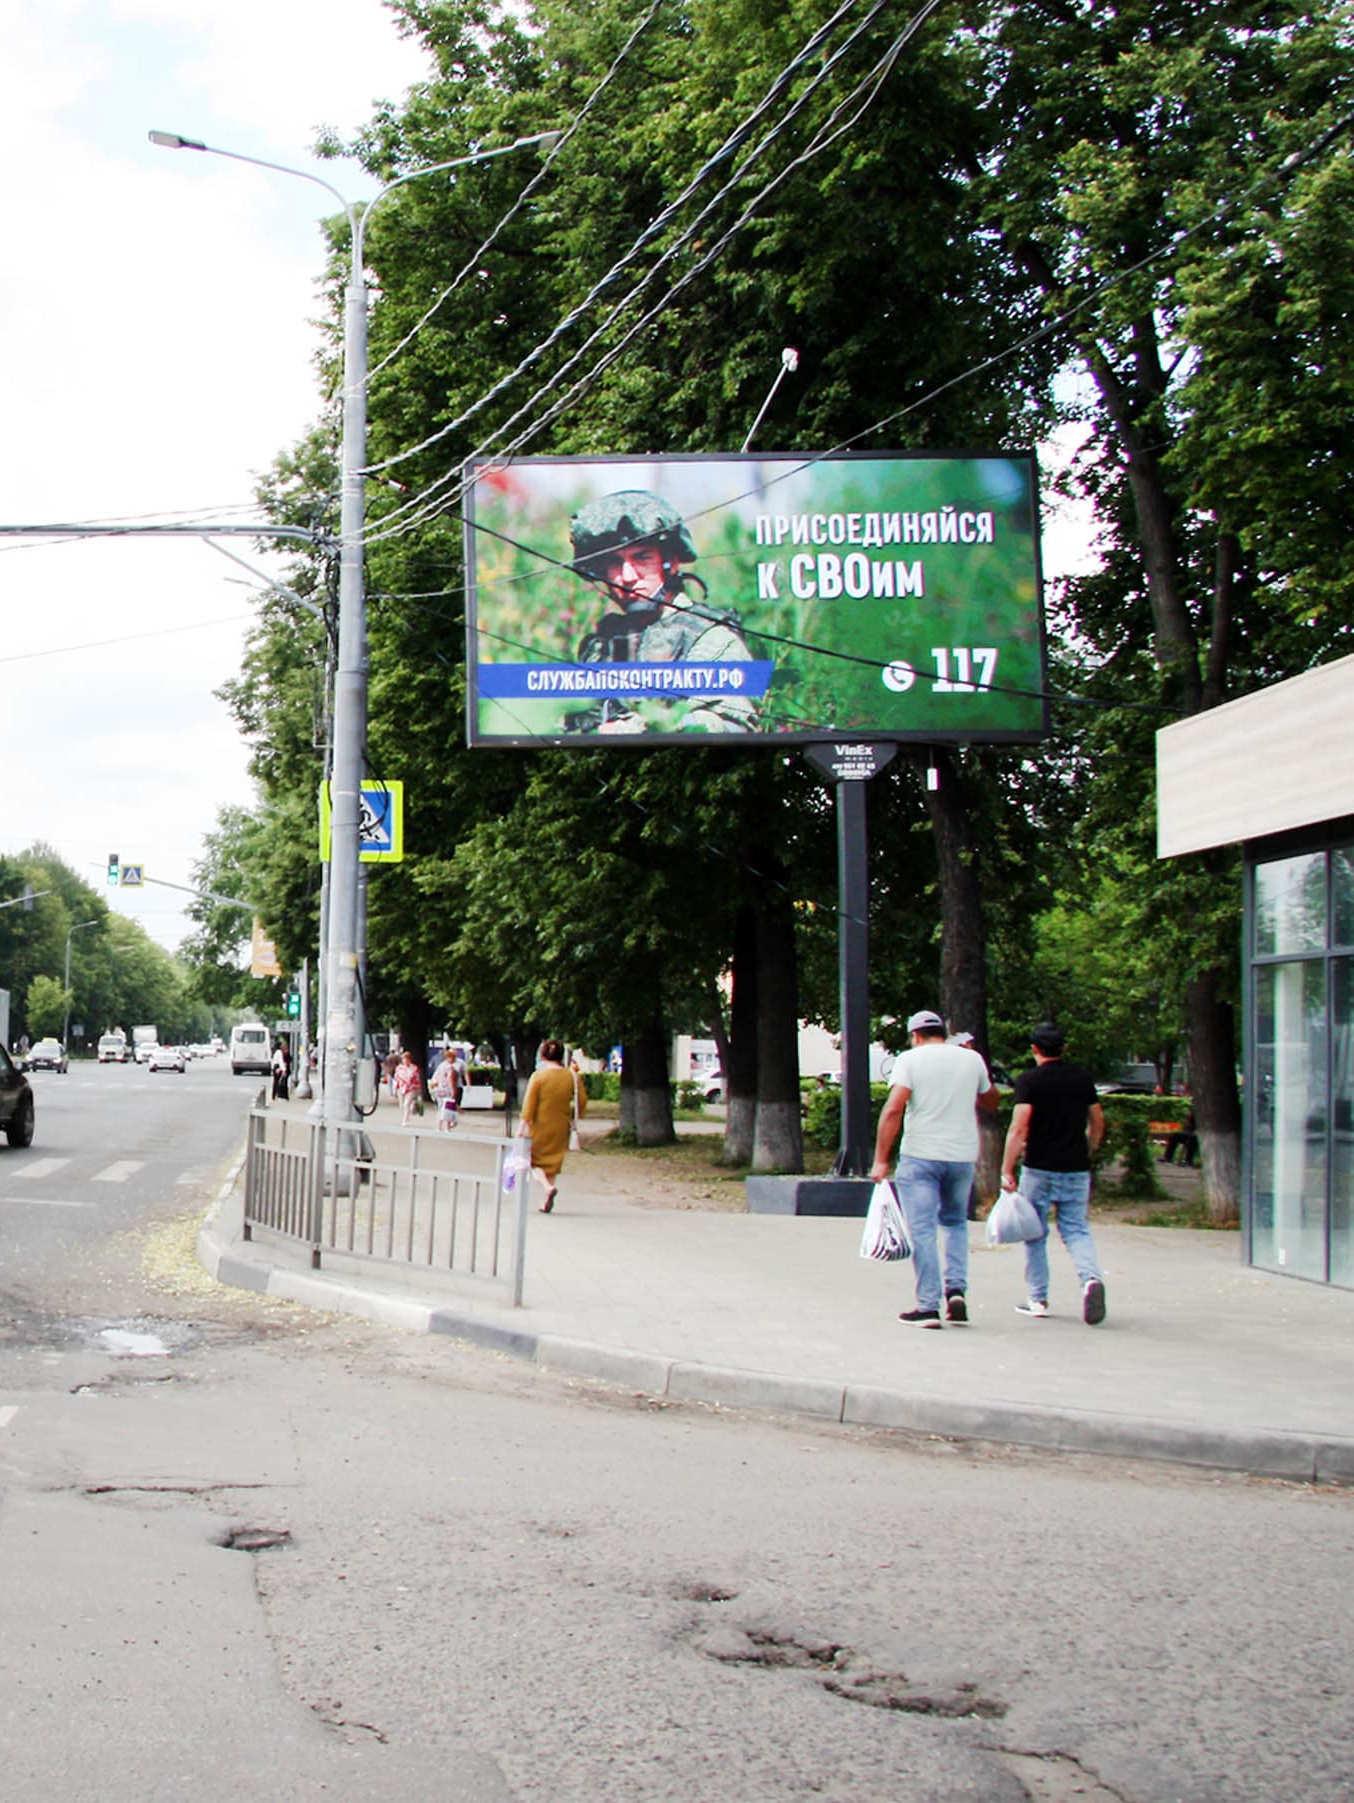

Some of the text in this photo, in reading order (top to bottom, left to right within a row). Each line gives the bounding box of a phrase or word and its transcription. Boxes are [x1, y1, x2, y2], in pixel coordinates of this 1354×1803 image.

[755, 506, 994, 548] ПРИСОЕДИНЯЙСЯ
[527, 668, 744, 691] СЛУЖБАПОКОНТРАКТУ.РФ
[931, 647, 998, 693] 117
